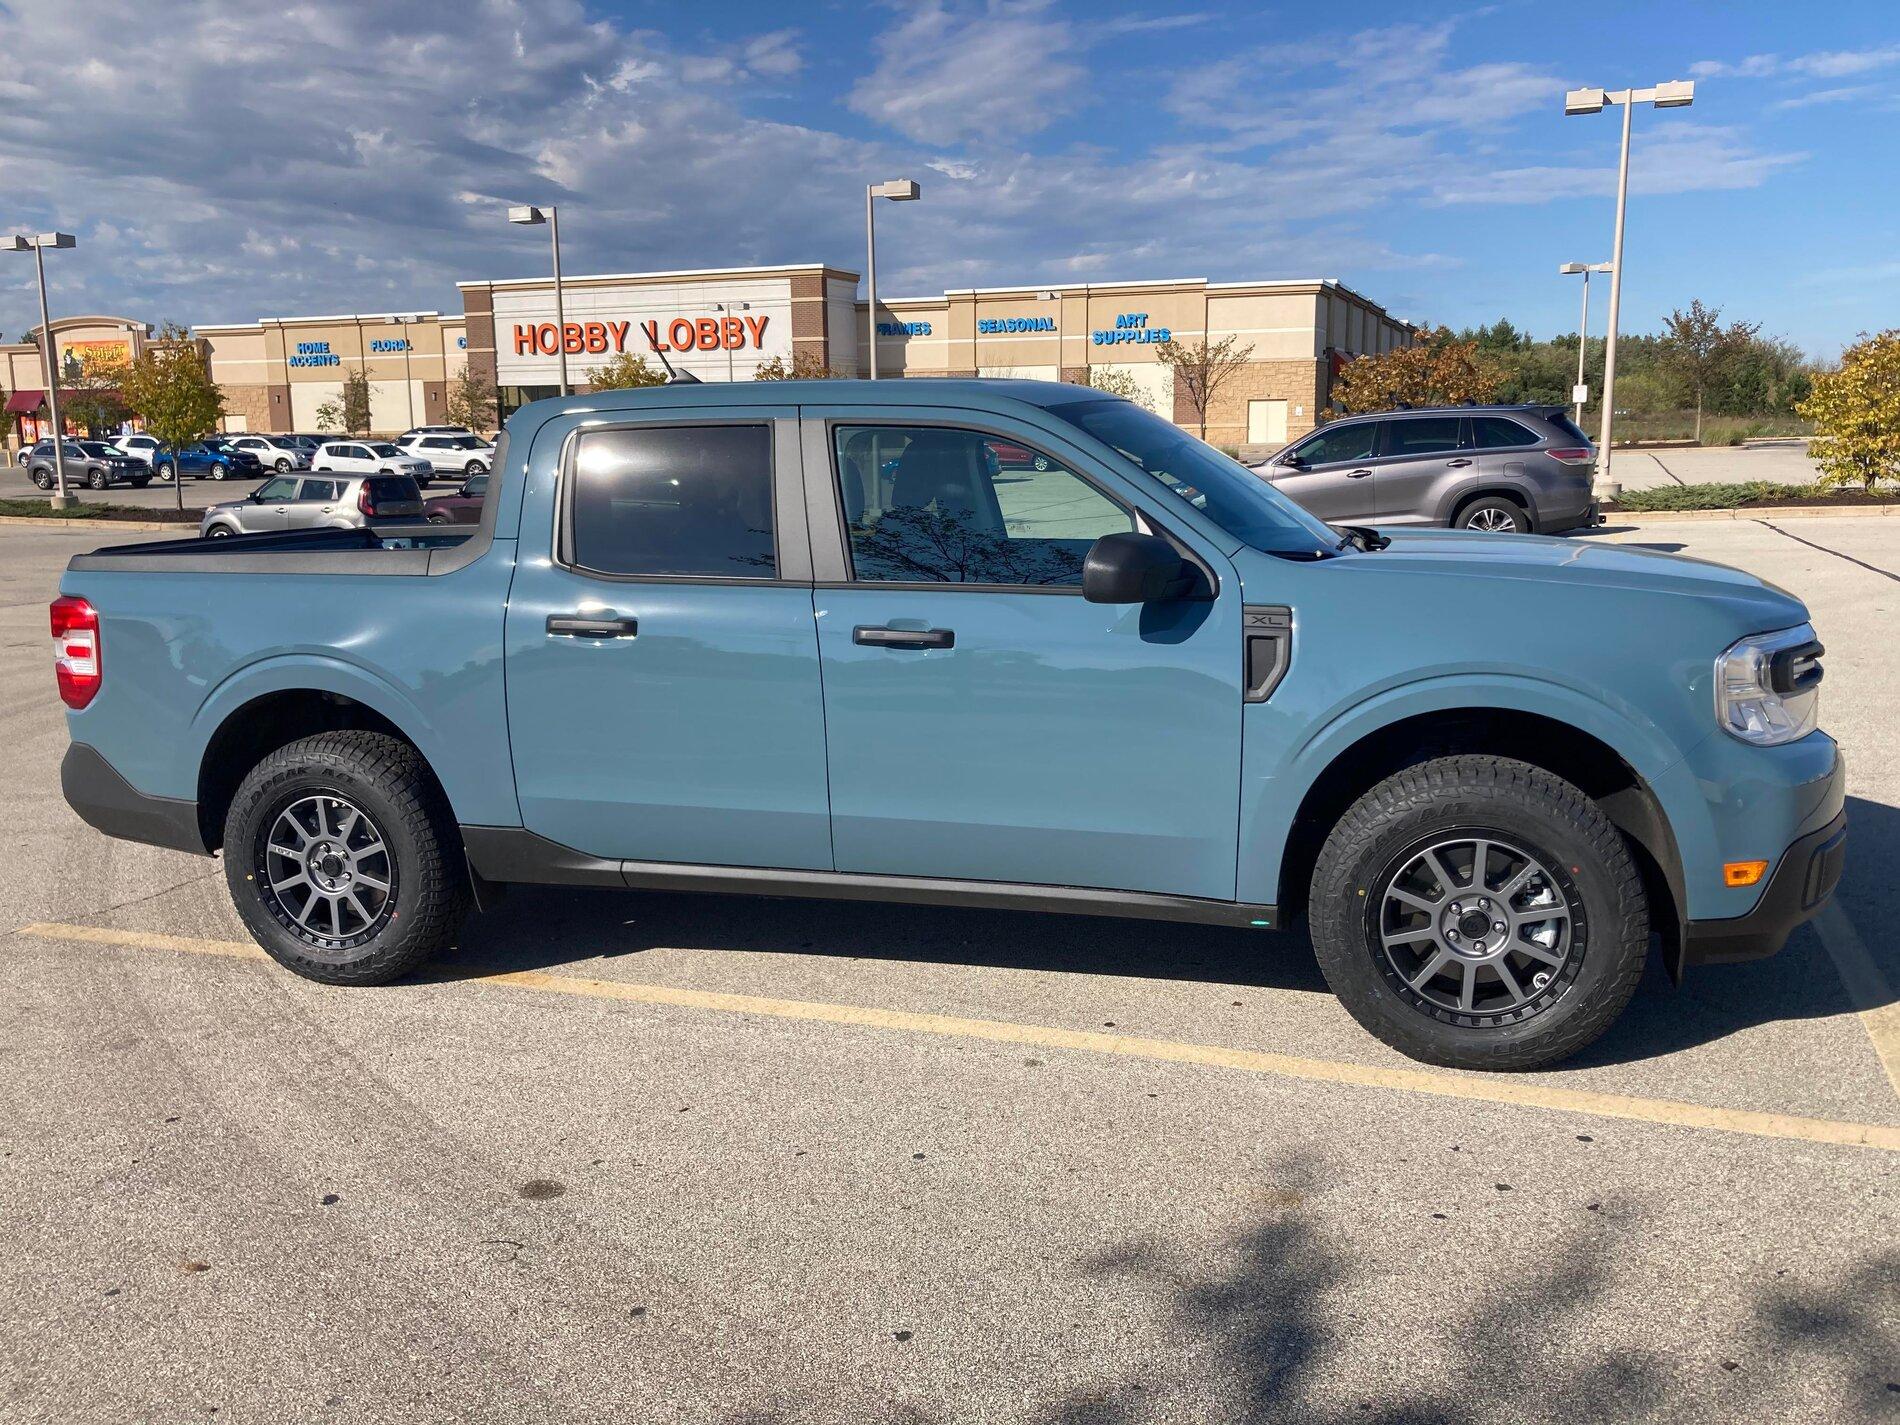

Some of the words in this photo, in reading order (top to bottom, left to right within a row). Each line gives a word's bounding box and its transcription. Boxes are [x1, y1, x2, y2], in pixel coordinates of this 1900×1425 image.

[977, 317, 1057, 333] SEASONAL
[1115, 312, 1149, 328] ART
[513, 321, 631, 355] HOBBY
[648, 316, 770, 351] LOBBY
[876, 322, 932, 336] FRAMES
[1091, 328, 1171, 345] SUPPLIES
[297, 342, 331, 355] HOME
[289, 354, 340, 368] ACCENTS
[1251, 616, 1283, 625] XL
